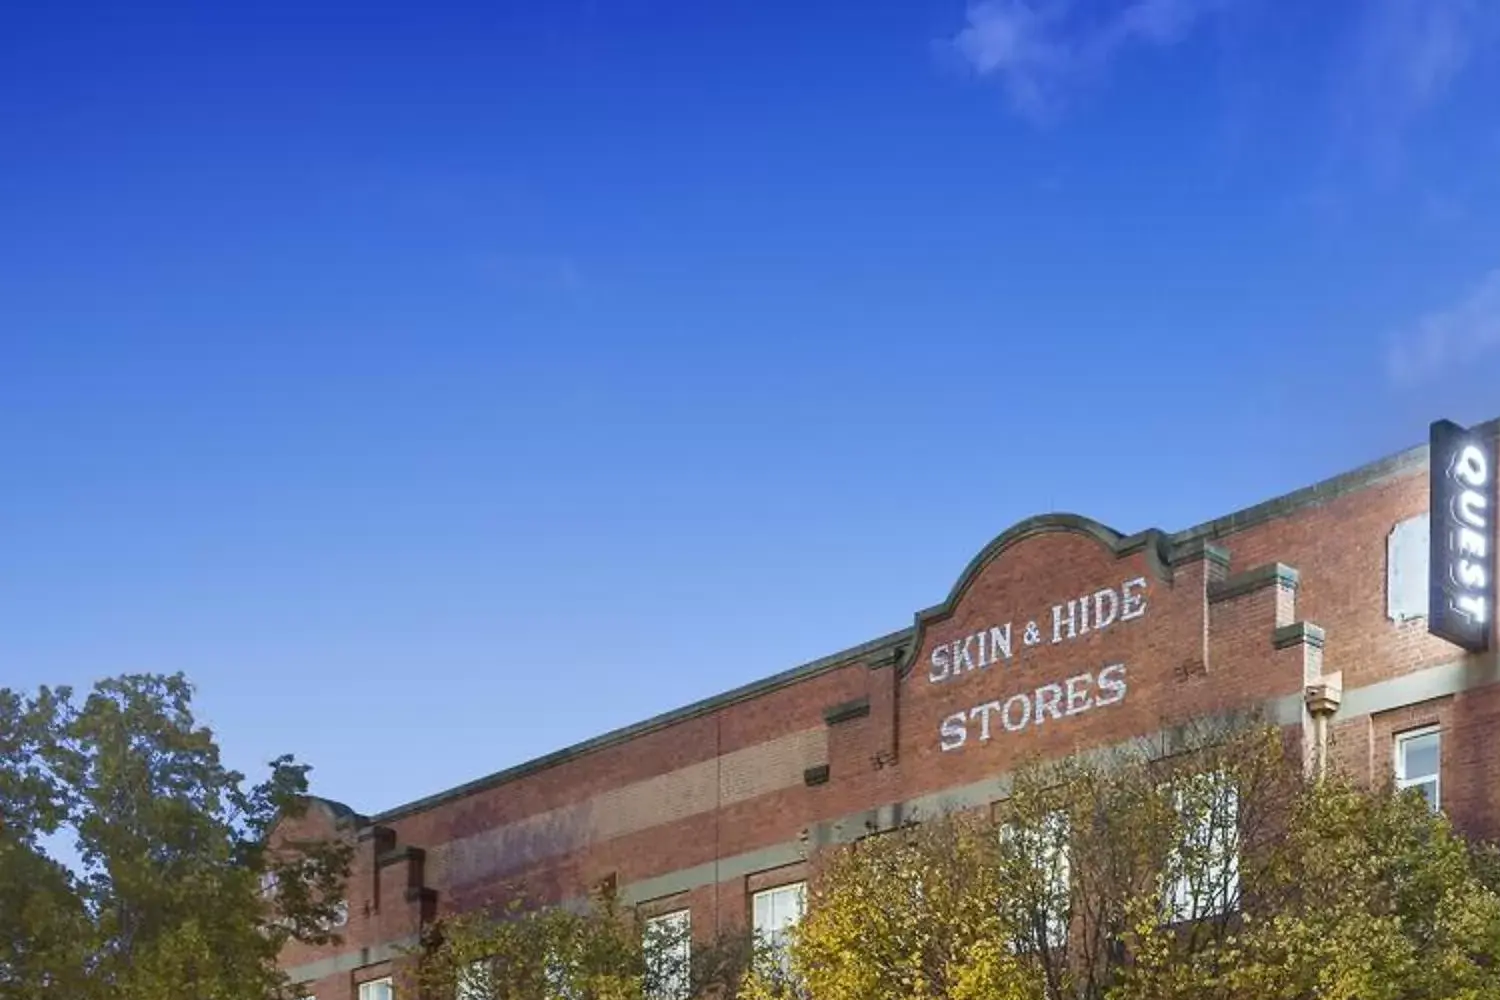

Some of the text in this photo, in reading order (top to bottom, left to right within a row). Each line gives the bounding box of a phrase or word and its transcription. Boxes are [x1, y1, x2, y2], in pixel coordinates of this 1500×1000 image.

[1452, 446, 1488, 623] QUEST
[928, 577, 1148, 683] SKIN & HIDE
[940, 663, 1128, 751] STORES
